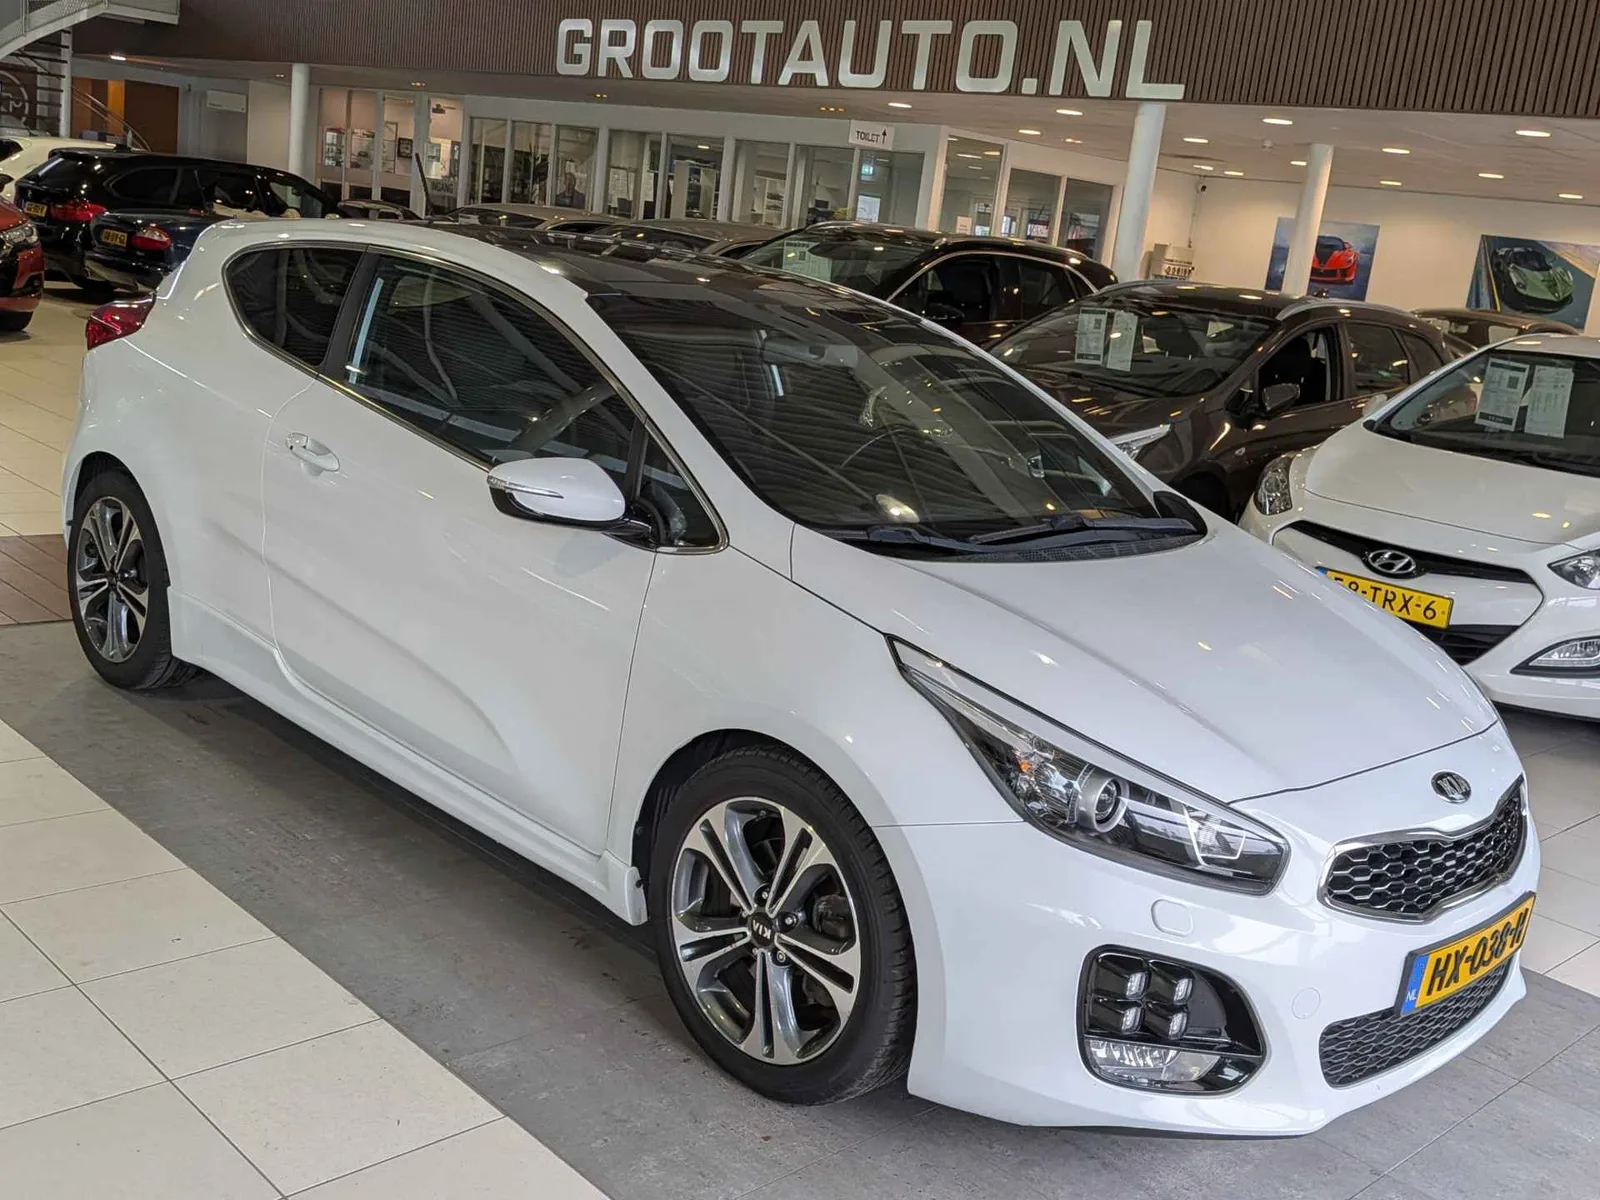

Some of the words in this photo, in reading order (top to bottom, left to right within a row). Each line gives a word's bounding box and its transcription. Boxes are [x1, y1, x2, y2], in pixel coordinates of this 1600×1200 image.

[556, 18, 1185, 100] GROOTAUTO.NL
[856, 130, 881, 143] TOILET
[1333, 576, 1437, 620] -TRX-6
[752, 919, 771, 939] KIA
[1426, 908, 1530, 996] HX-038-H
[1405, 989, 1417, 1002] NL
